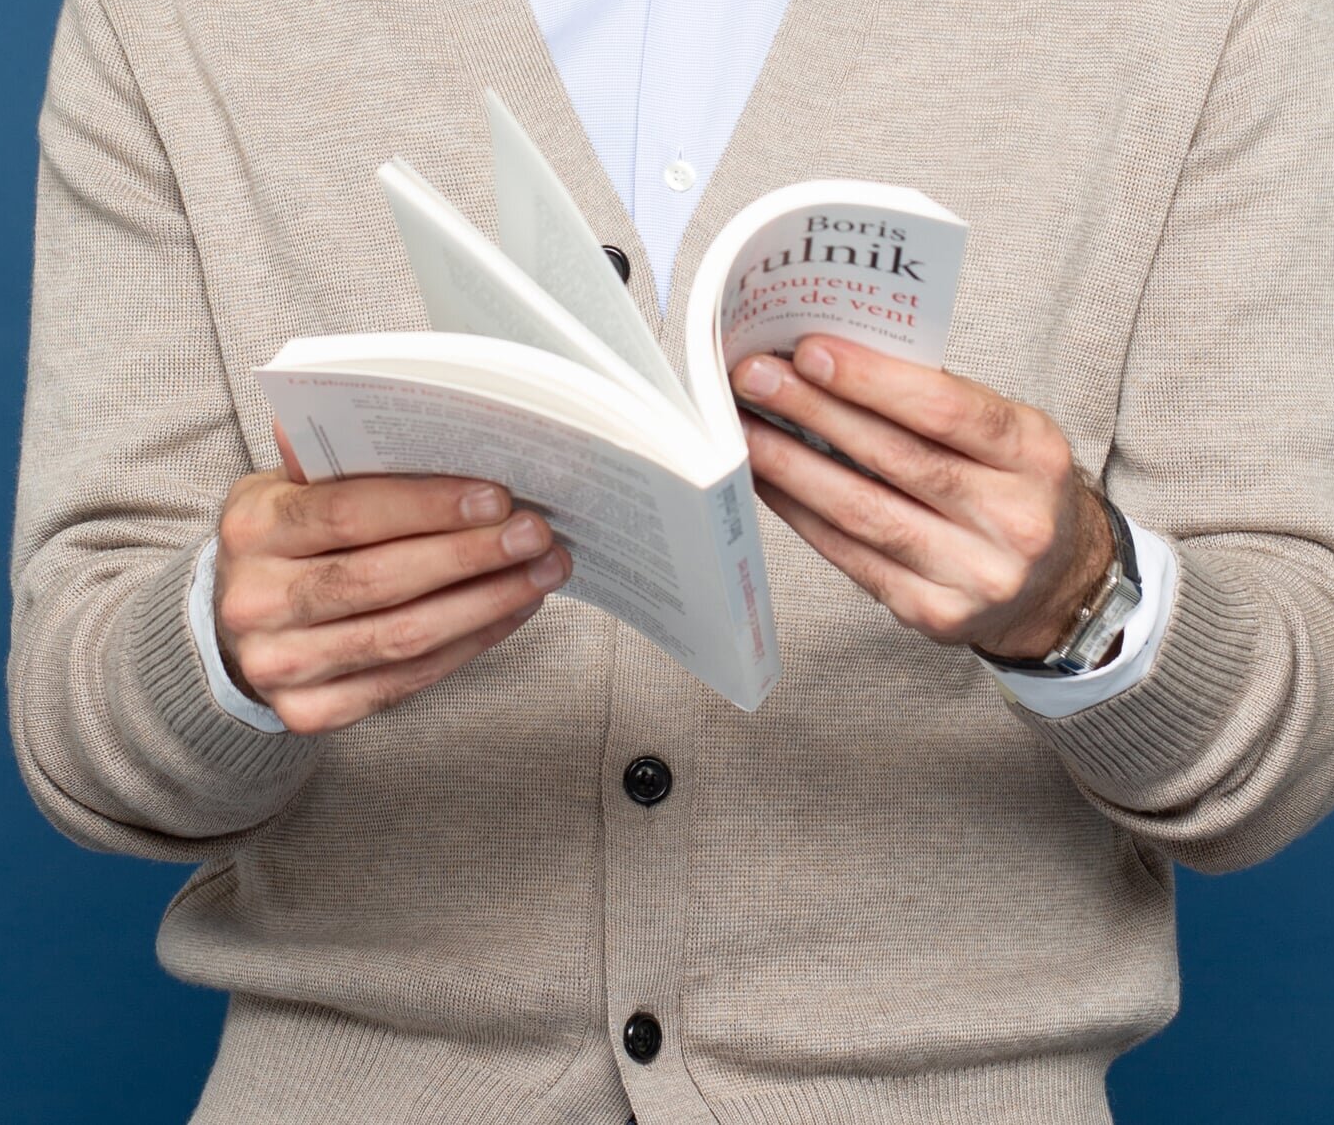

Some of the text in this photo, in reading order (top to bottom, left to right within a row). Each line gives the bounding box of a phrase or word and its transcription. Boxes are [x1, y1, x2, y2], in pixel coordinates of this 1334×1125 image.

[806, 215, 907, 242] Boris
[800, 290, 837, 306] de
[850, 298, 916, 328] vent
[892, 289, 919, 309] et
[848, 318, 916, 345] servitude
